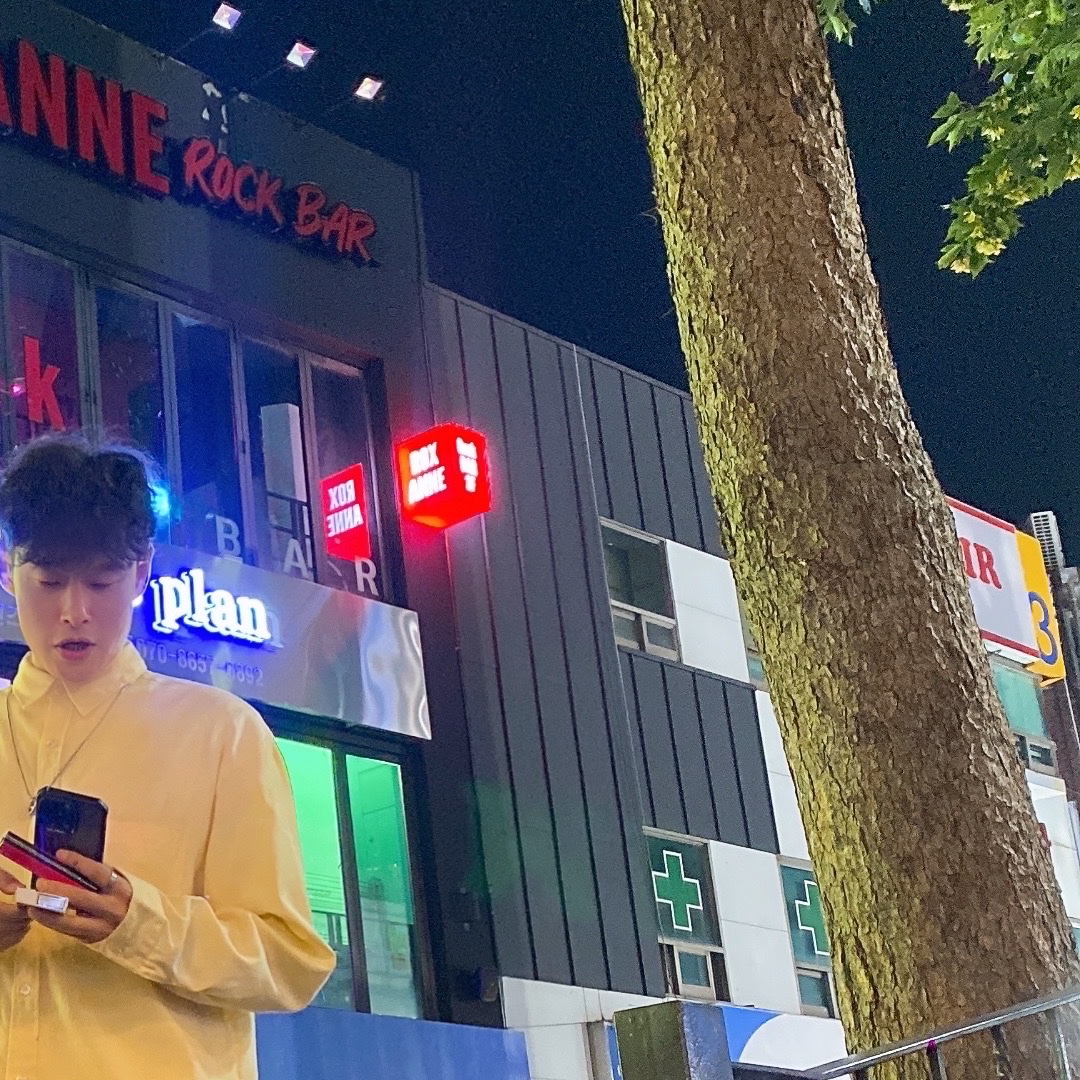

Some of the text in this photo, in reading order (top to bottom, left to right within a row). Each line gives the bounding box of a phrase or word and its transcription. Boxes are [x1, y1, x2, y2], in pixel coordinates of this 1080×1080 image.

[183, 135, 286, 230] ROCK
[294, 181, 378, 264] BAR
[958, 536, 1003, 591] IR
